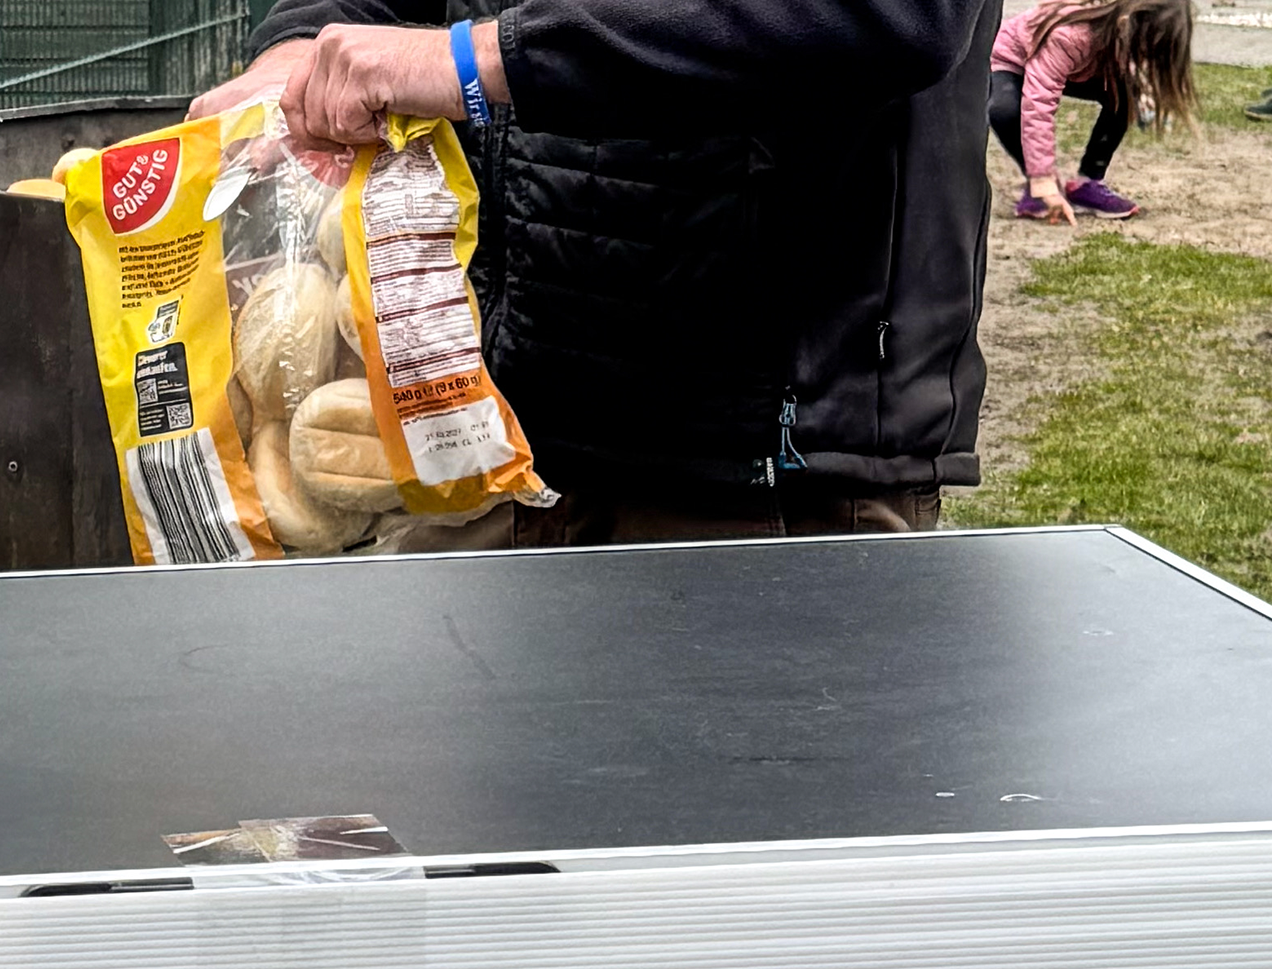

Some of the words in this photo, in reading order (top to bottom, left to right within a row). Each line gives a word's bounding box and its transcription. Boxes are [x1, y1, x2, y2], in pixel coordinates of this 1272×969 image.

[464, 77, 482, 110] Wir
[112, 163, 143, 199] GUT
[136, 154, 149, 166] &
[112, 149, 168, 221] GÜNSTIG
[393, 389, 413, 405] 540
[435, 381, 447, 397] (9
[448, 381, 455, 391] x
[455, 377, 469, 389] 60
